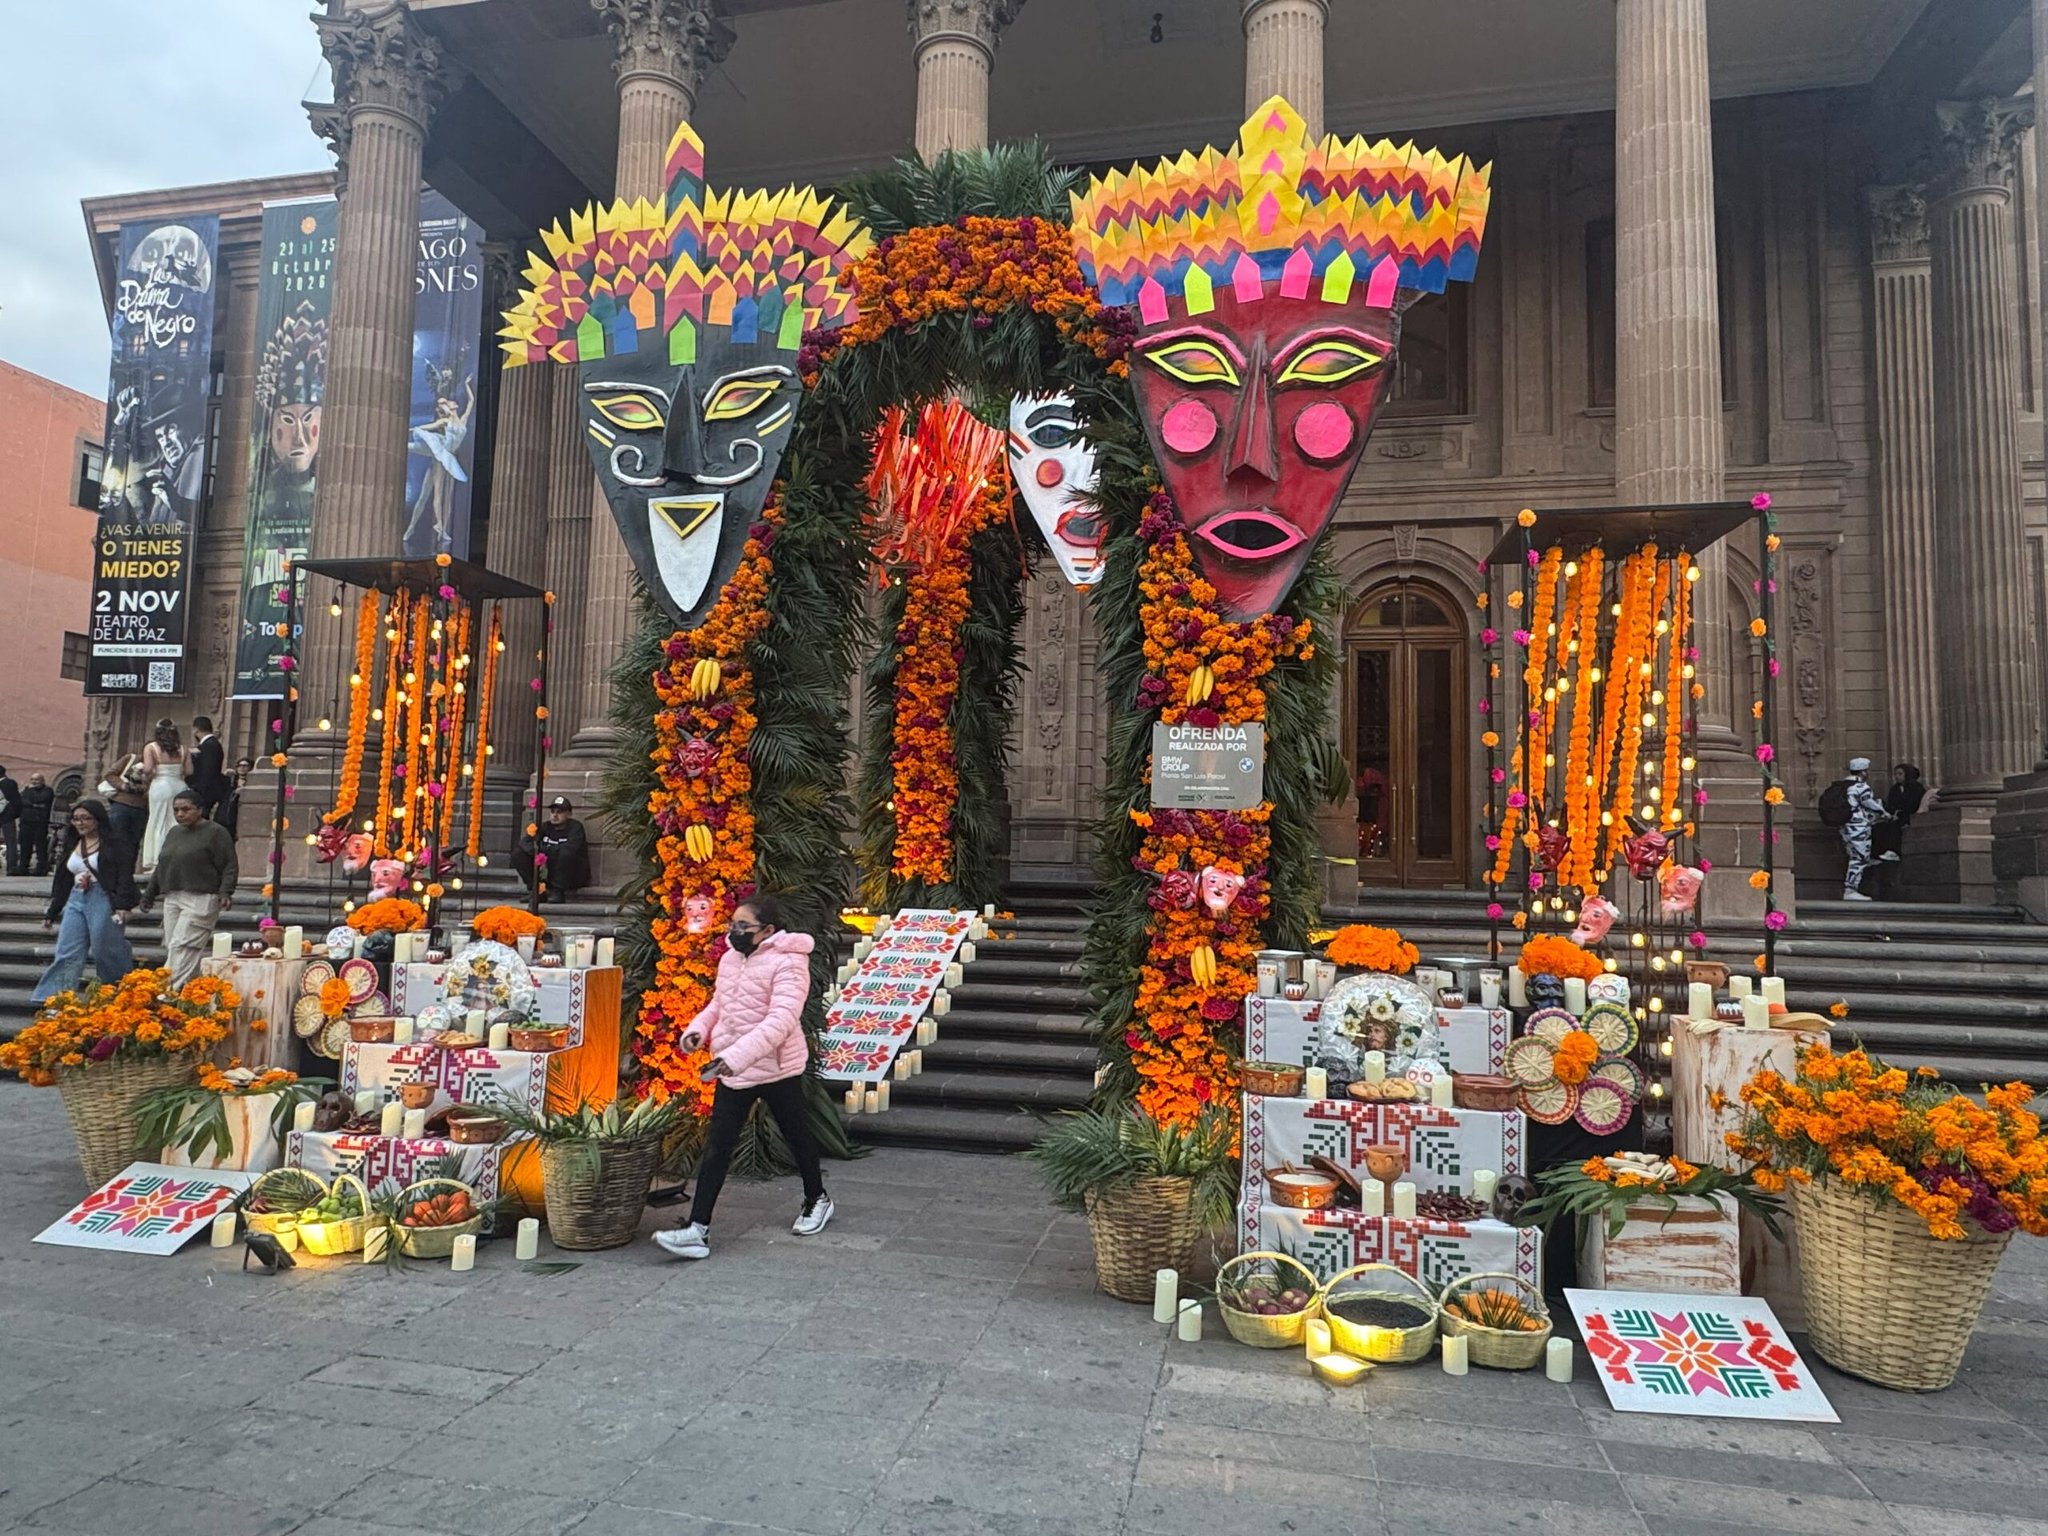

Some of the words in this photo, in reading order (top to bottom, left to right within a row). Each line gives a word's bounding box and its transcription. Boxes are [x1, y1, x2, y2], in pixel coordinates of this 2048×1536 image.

[419, 237, 467, 260] AGO
[415, 264, 478, 294] SNES
[118, 280, 184, 315] Dama
[144, 306, 196, 348] Negro
[101, 524, 131, 539] ¿VAS
[134, 524, 144, 535] A
[102, 540, 117, 556] O
[122, 540, 182, 556] TIENES
[101, 560, 181, 578] MIEDO?
[95, 590, 112, 612] 2
[118, 590, 180, 613] NOV
[94, 615, 150, 628] TEATRO
[93, 628, 112, 641] DE
[116, 628, 135, 641] LA
[138, 628, 166, 641] PAZ
[1169, 727, 1248, 741] OFRENDA
[1168, 742, 1224, 751] REALIZADA
[1226, 743, 1247, 752] POR
[1161, 756, 1182, 764] BMW
[1161, 764, 1190, 772] GROUP
